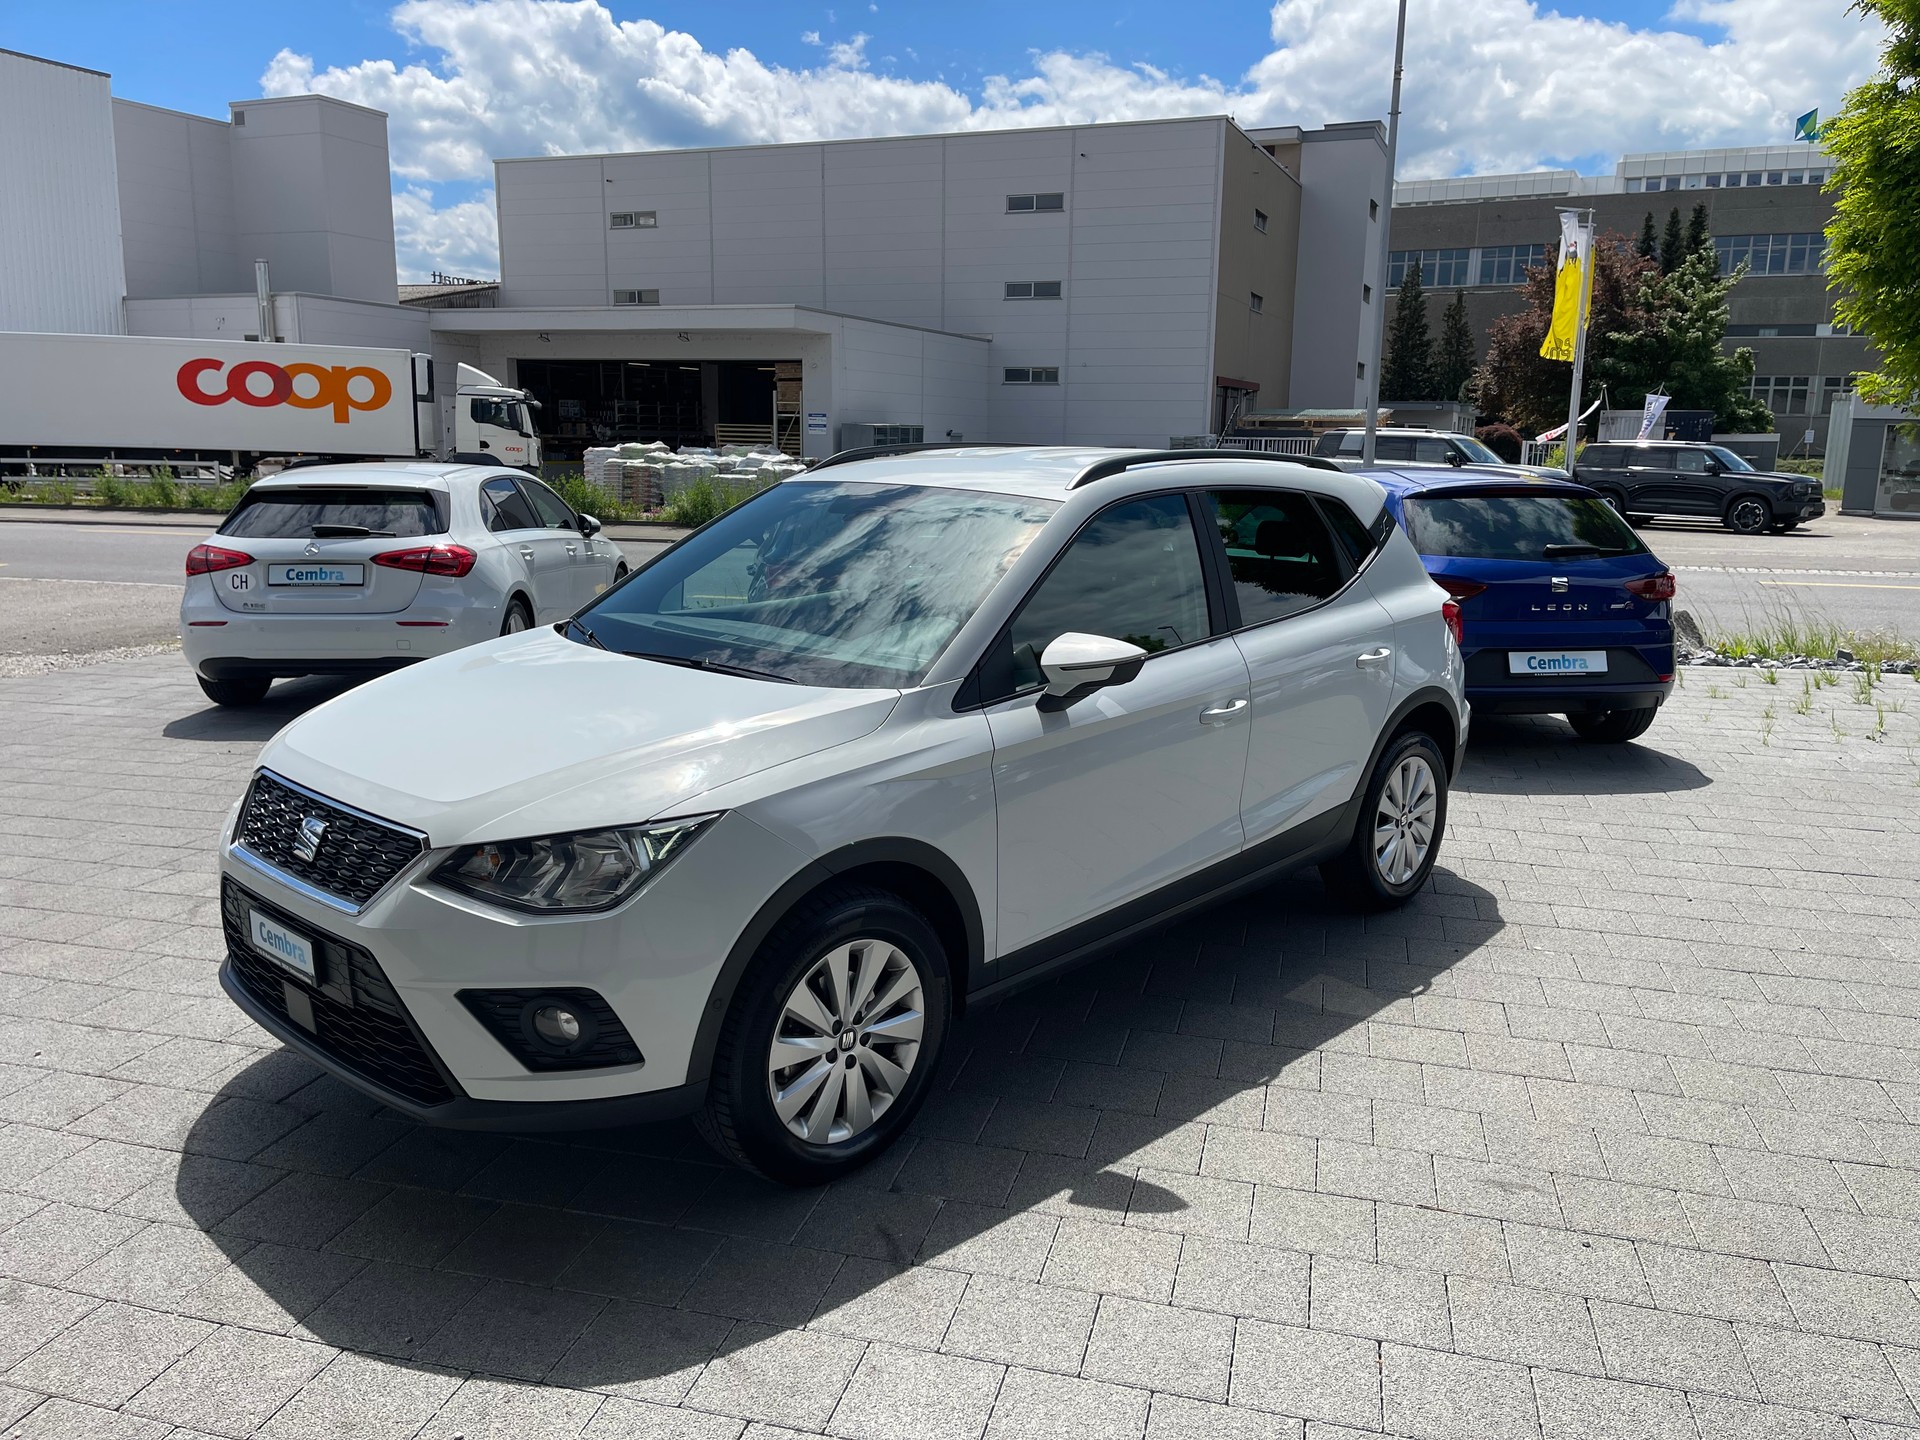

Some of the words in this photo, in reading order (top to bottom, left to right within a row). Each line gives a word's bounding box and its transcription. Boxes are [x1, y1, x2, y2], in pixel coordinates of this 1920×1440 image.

[177, 358, 392, 424] coop
[231, 574, 248, 590] CH
[285, 567, 345, 581] Cembra
[1531, 603, 1588, 611] LEON
[1527, 654, 1589, 670] Cembra
[259, 921, 307, 965] Cembra
